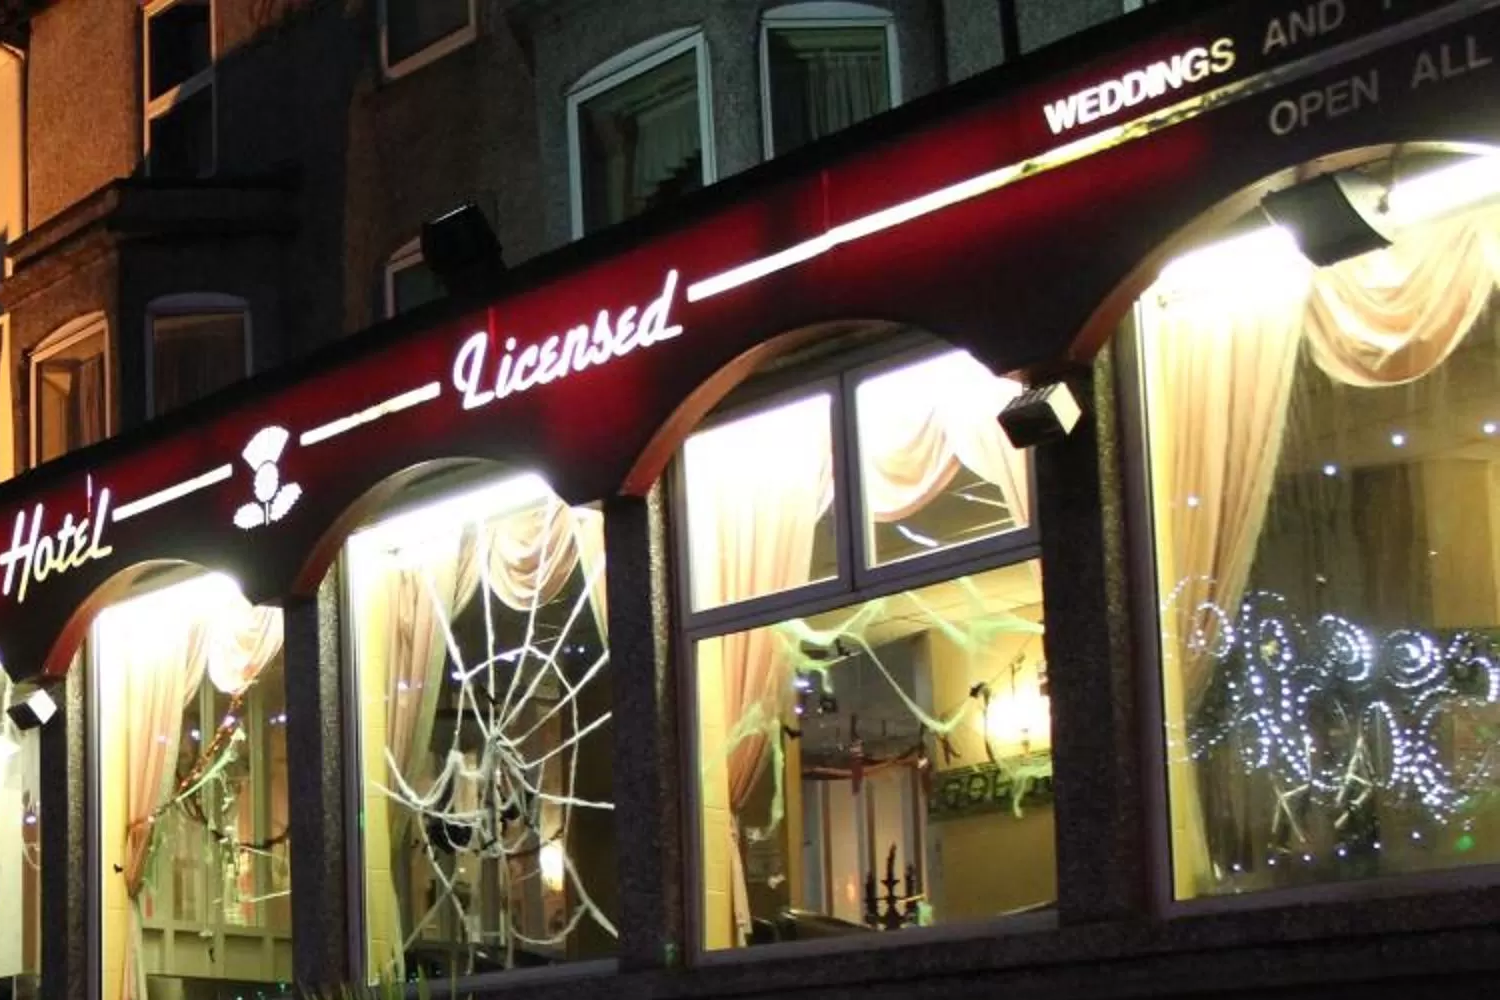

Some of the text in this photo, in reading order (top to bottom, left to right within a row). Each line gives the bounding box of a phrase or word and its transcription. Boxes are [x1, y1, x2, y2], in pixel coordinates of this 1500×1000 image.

[1043, 0, 1345, 135] WEDDINGS AND
[1268, 35, 1493, 136] OPEN ALL
[453, 268, 683, 410] Licensed
